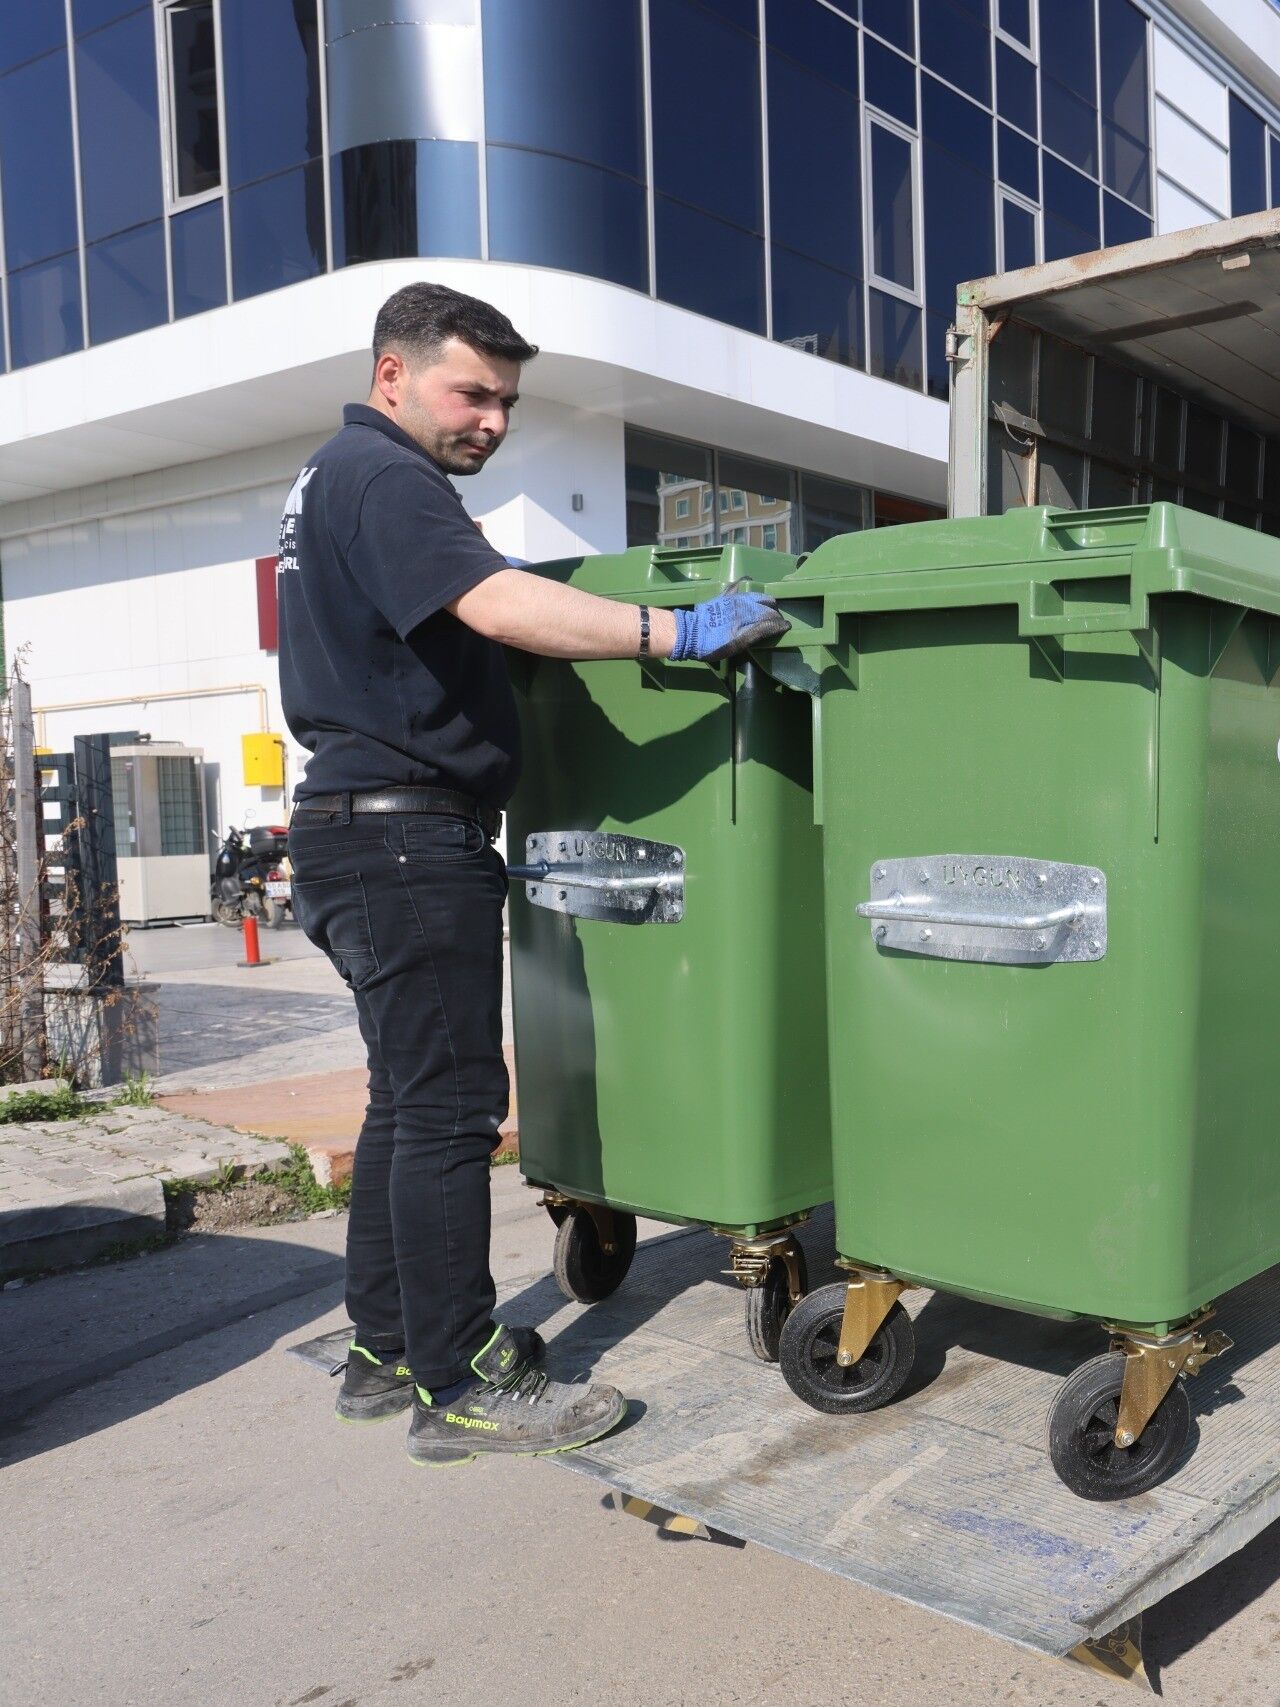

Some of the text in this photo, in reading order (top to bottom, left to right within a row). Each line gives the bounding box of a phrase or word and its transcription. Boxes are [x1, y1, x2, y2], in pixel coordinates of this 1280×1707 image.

[574, 838, 627, 861] UYGUN
[943, 865, 1020, 890] UYGUN
[446, 1413, 499, 1431] Baymax
